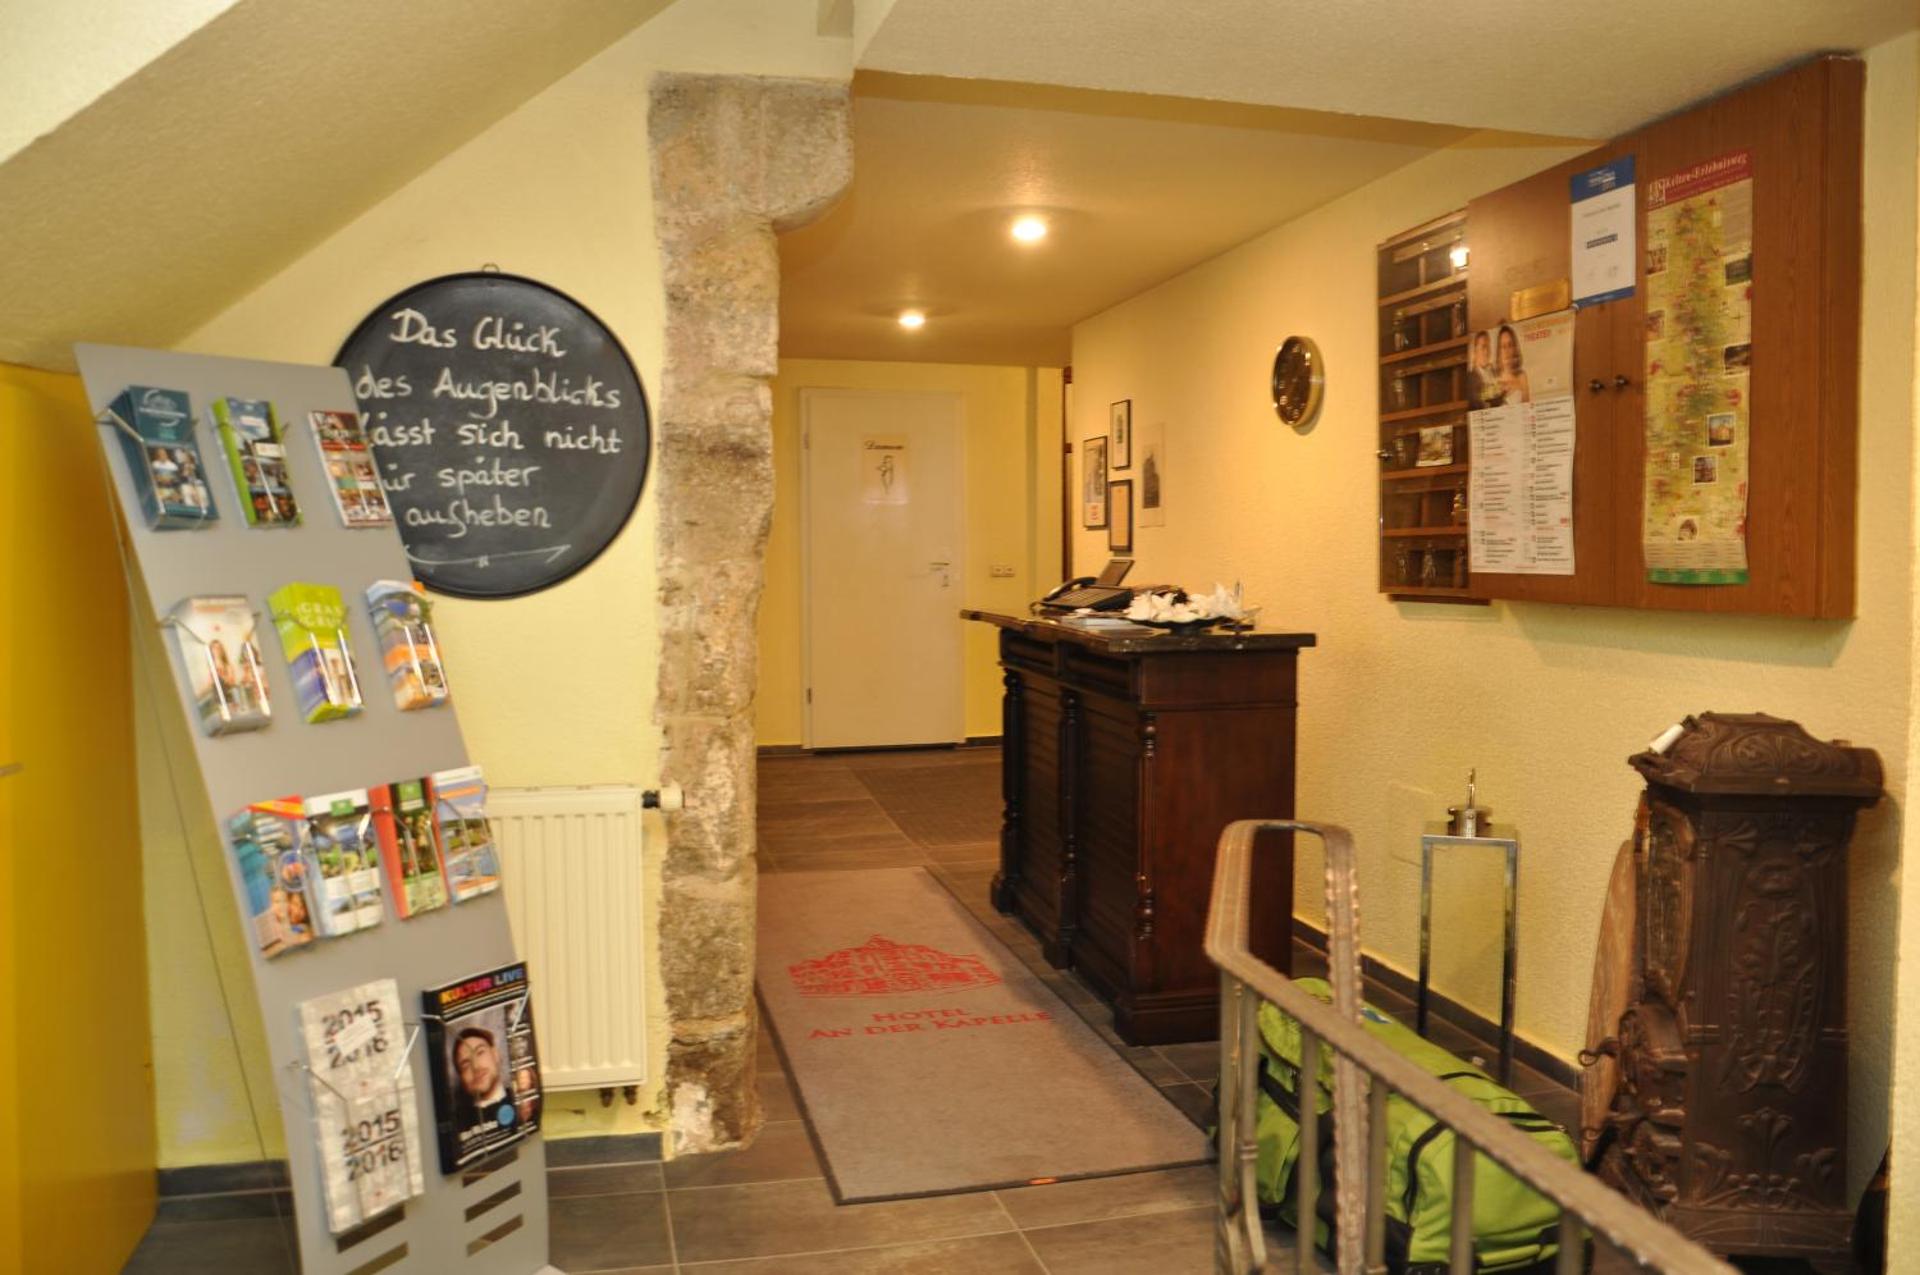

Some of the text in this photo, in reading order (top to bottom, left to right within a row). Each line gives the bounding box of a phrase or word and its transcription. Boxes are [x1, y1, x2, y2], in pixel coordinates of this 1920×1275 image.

[389, 307, 567, 358] Das Glück
[355, 364, 622, 420] des Augenblicks
[456, 419, 525, 450] sich
[544, 424, 624, 454] nicht
[382, 455, 542, 496] ür später
[406, 494, 552, 539] aufheben
[440, 967, 524, 1005] KULTUR LIVE
[808, 1010, 1054, 1040] AN DER KAPELLE
[872, 1008, 968, 1023] HOTEL
[341, 1108, 400, 1151] 2015
[346, 1140, 405, 1182] 2016
